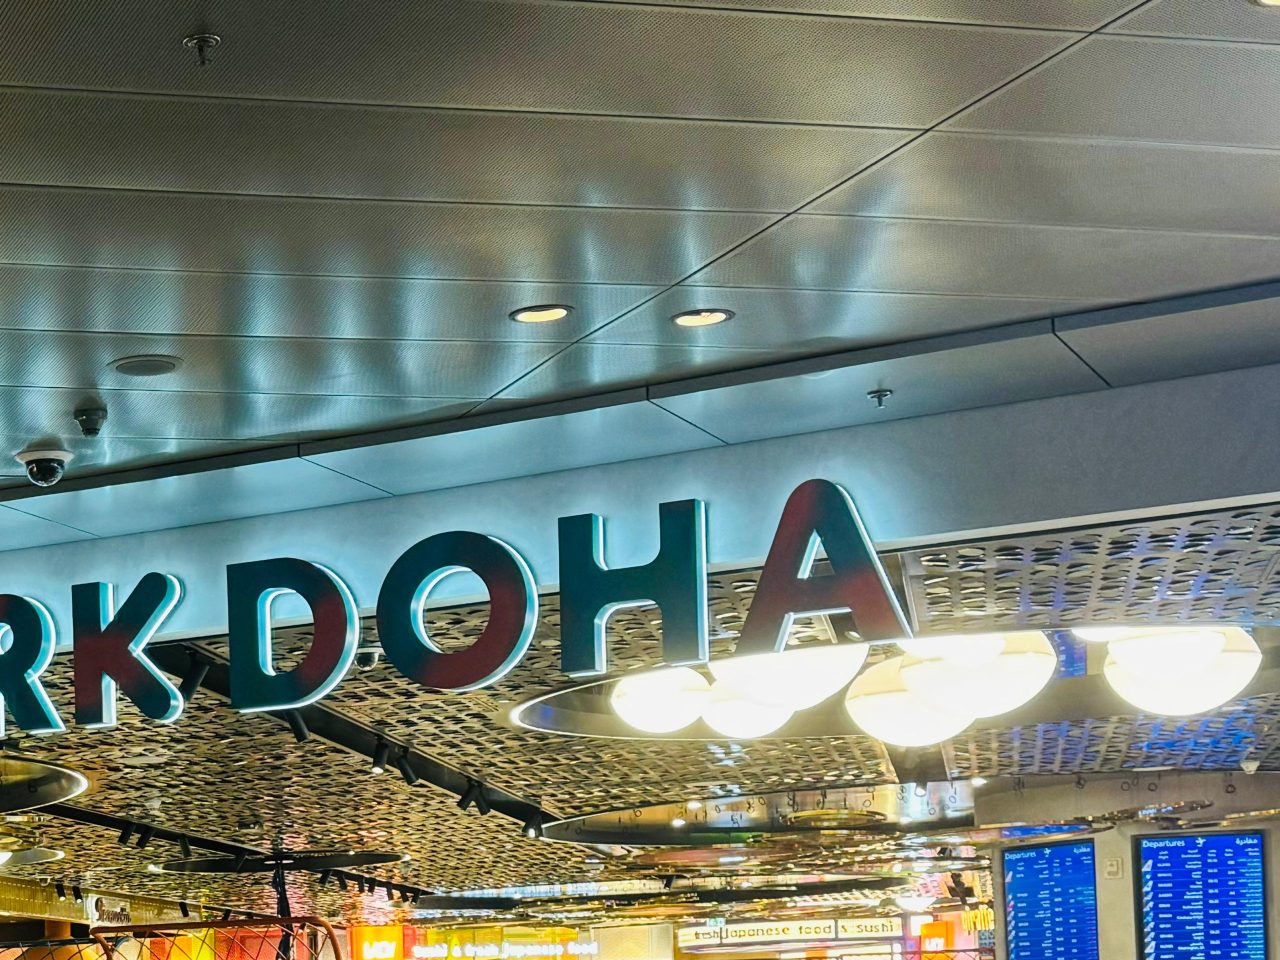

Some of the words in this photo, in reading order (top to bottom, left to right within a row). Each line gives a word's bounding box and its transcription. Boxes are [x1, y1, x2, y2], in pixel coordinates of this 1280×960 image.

[227, 479, 912, 713] DOHA
[1143, 840, 1186, 849] Departures
[1005, 852, 1037, 860] Departures
[798, 923, 832, 935] food
